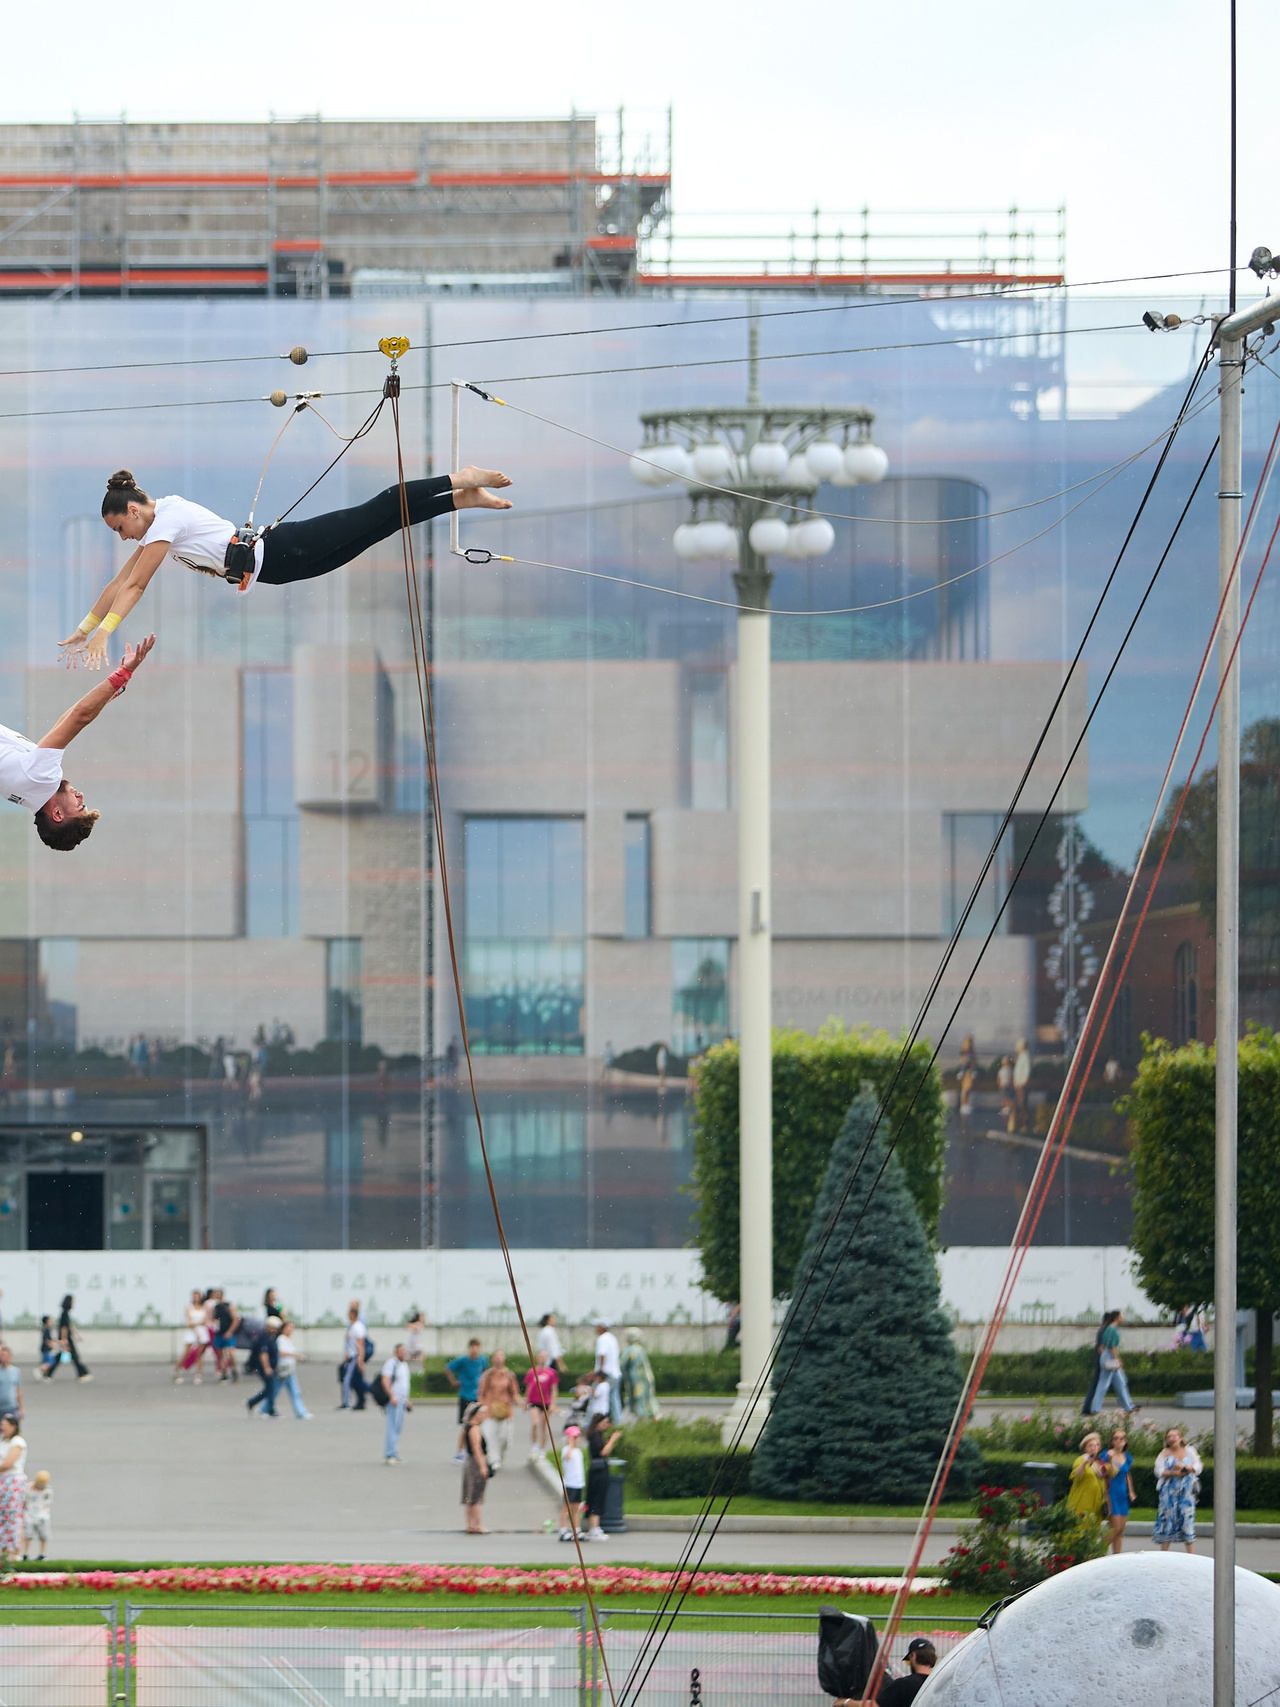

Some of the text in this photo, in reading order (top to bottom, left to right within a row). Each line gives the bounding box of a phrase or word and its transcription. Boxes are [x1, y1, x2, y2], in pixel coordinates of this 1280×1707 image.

[326, 749, 371, 796] 12
[65, 1273, 149, 1290] ВДНХ
[330, 1272, 413, 1290] ВДНХ
[595, 1271, 677, 1290] ВДНХ
